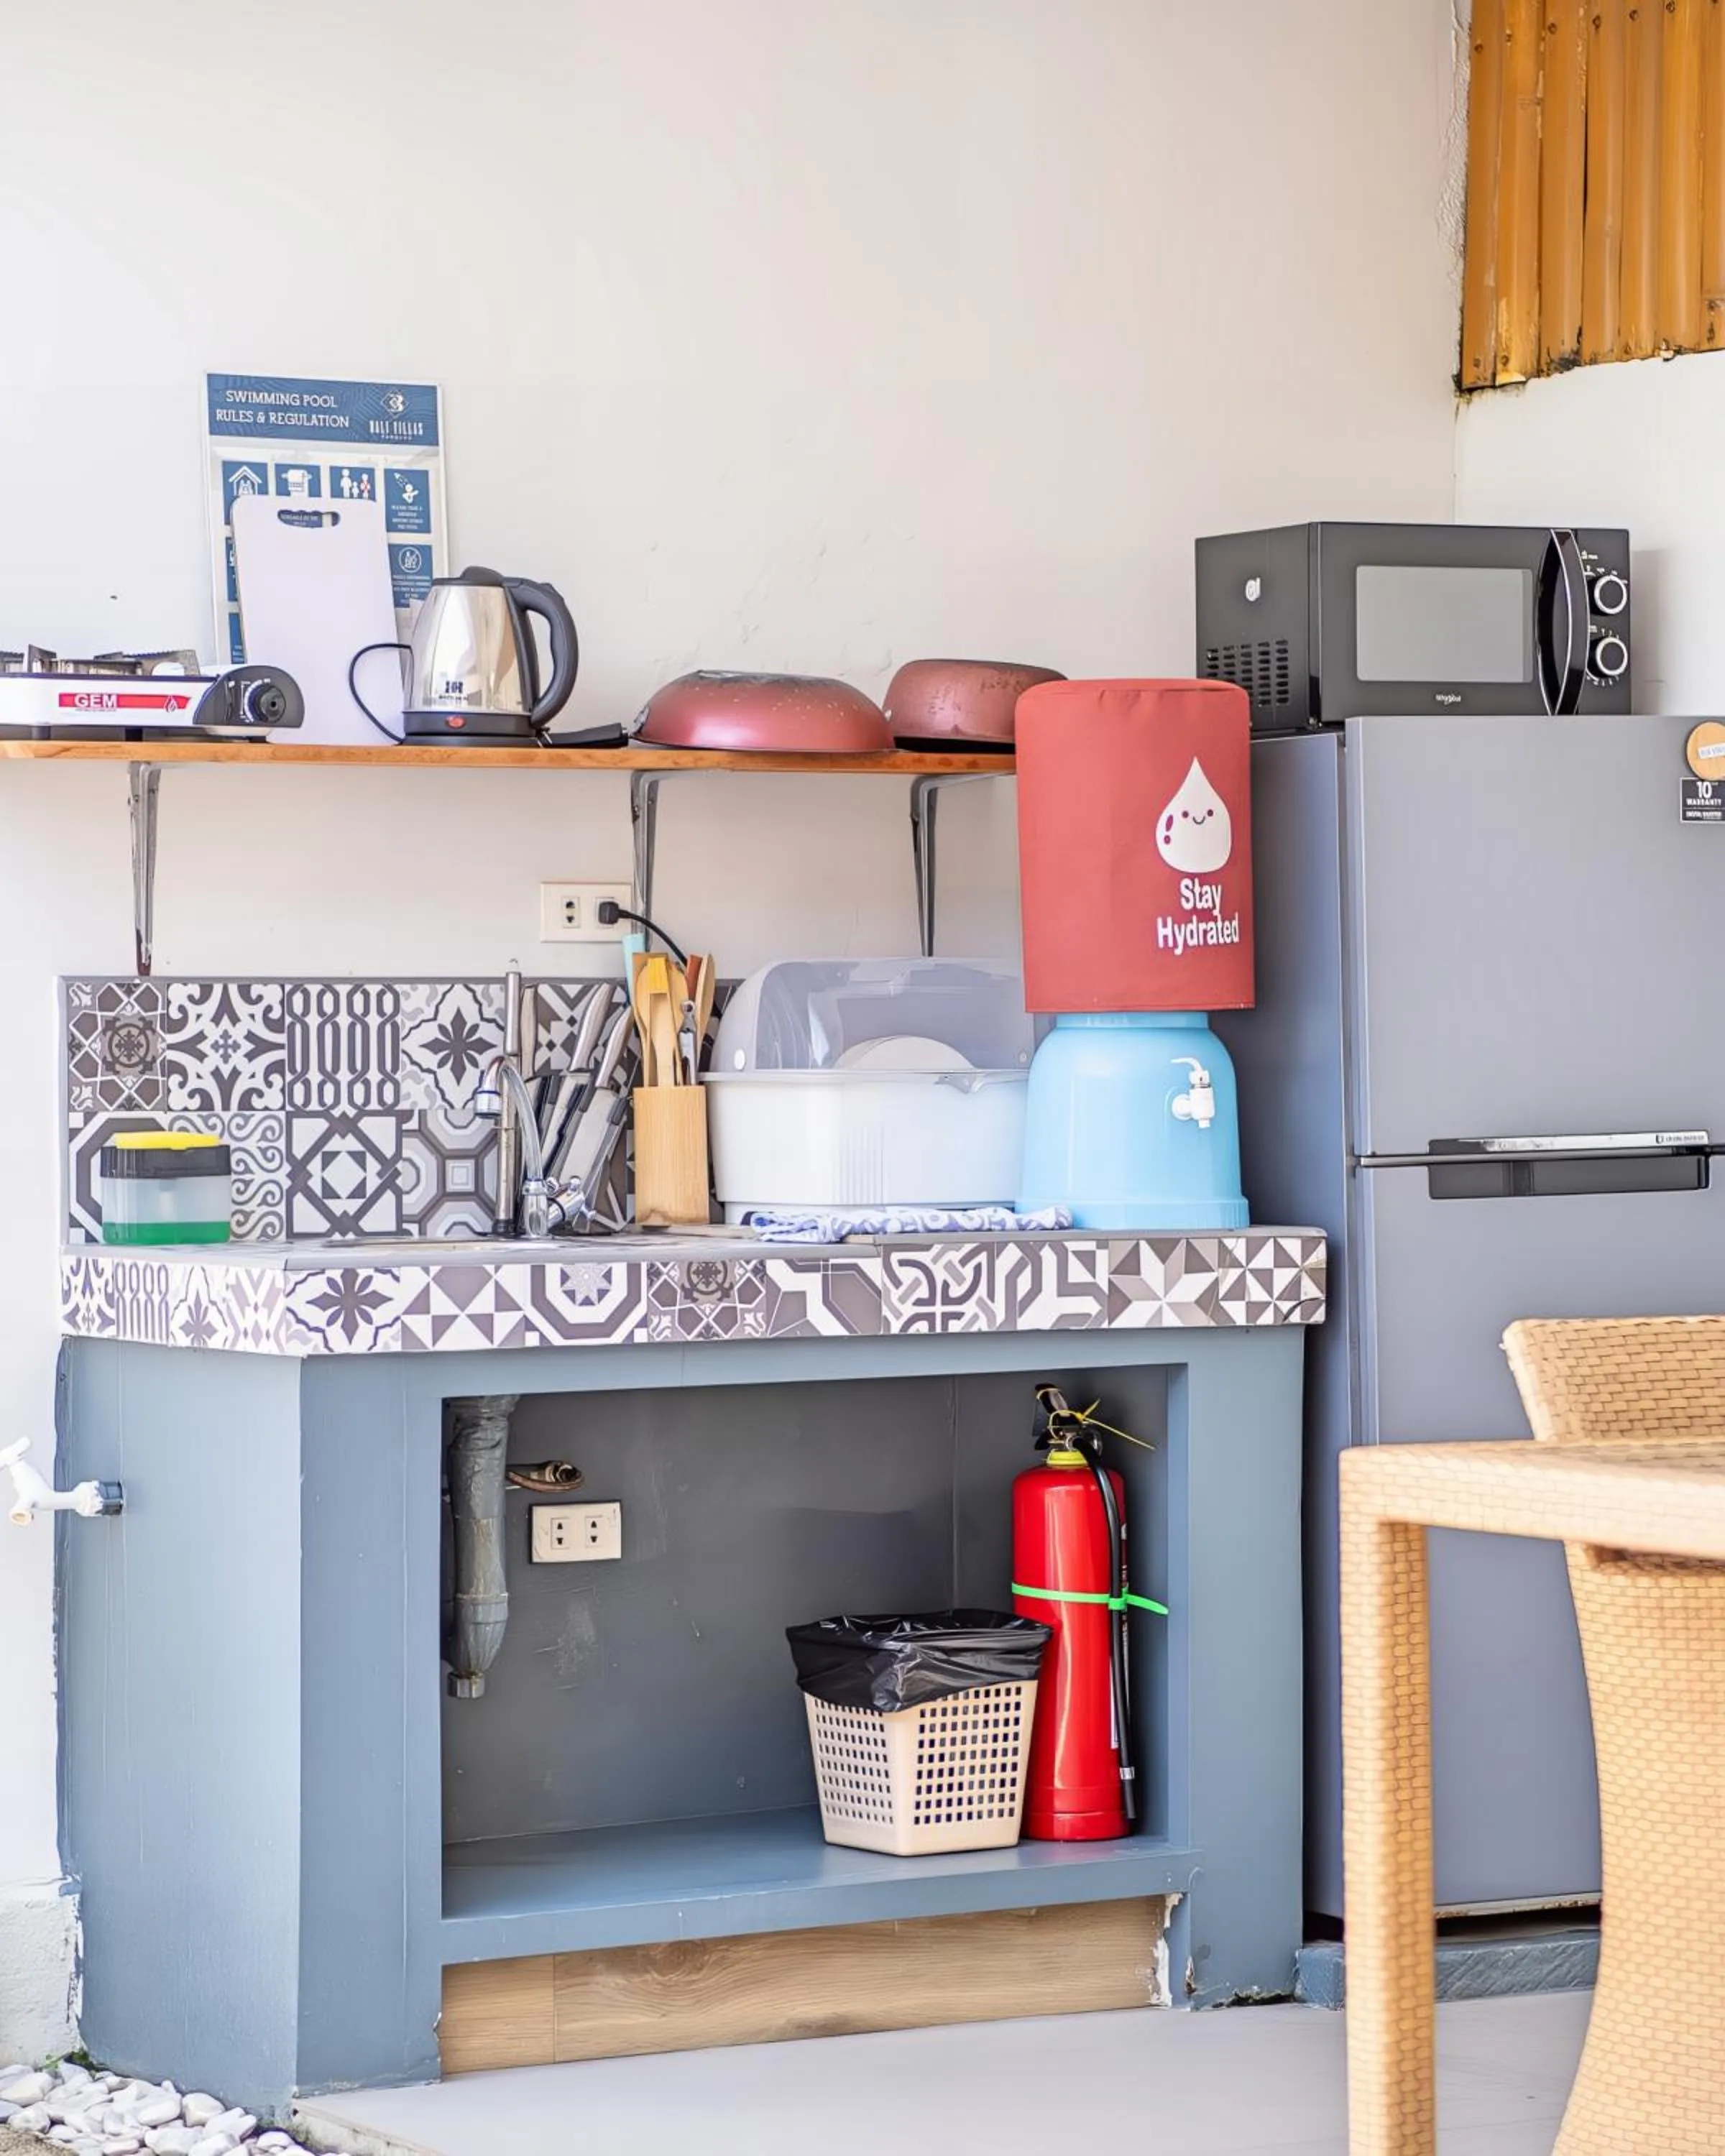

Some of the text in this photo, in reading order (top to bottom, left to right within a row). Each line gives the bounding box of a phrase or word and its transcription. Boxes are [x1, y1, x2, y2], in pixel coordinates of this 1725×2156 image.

[226, 390, 339, 407] SWIMMING POOL
[216, 409, 349, 428] RULES & REGULATION
[74, 694, 117, 708] GEM
[1696, 781, 1712, 798] 10
[1179, 877, 1221, 916] Stay
[1156, 911, 1240, 956] Hydrated
